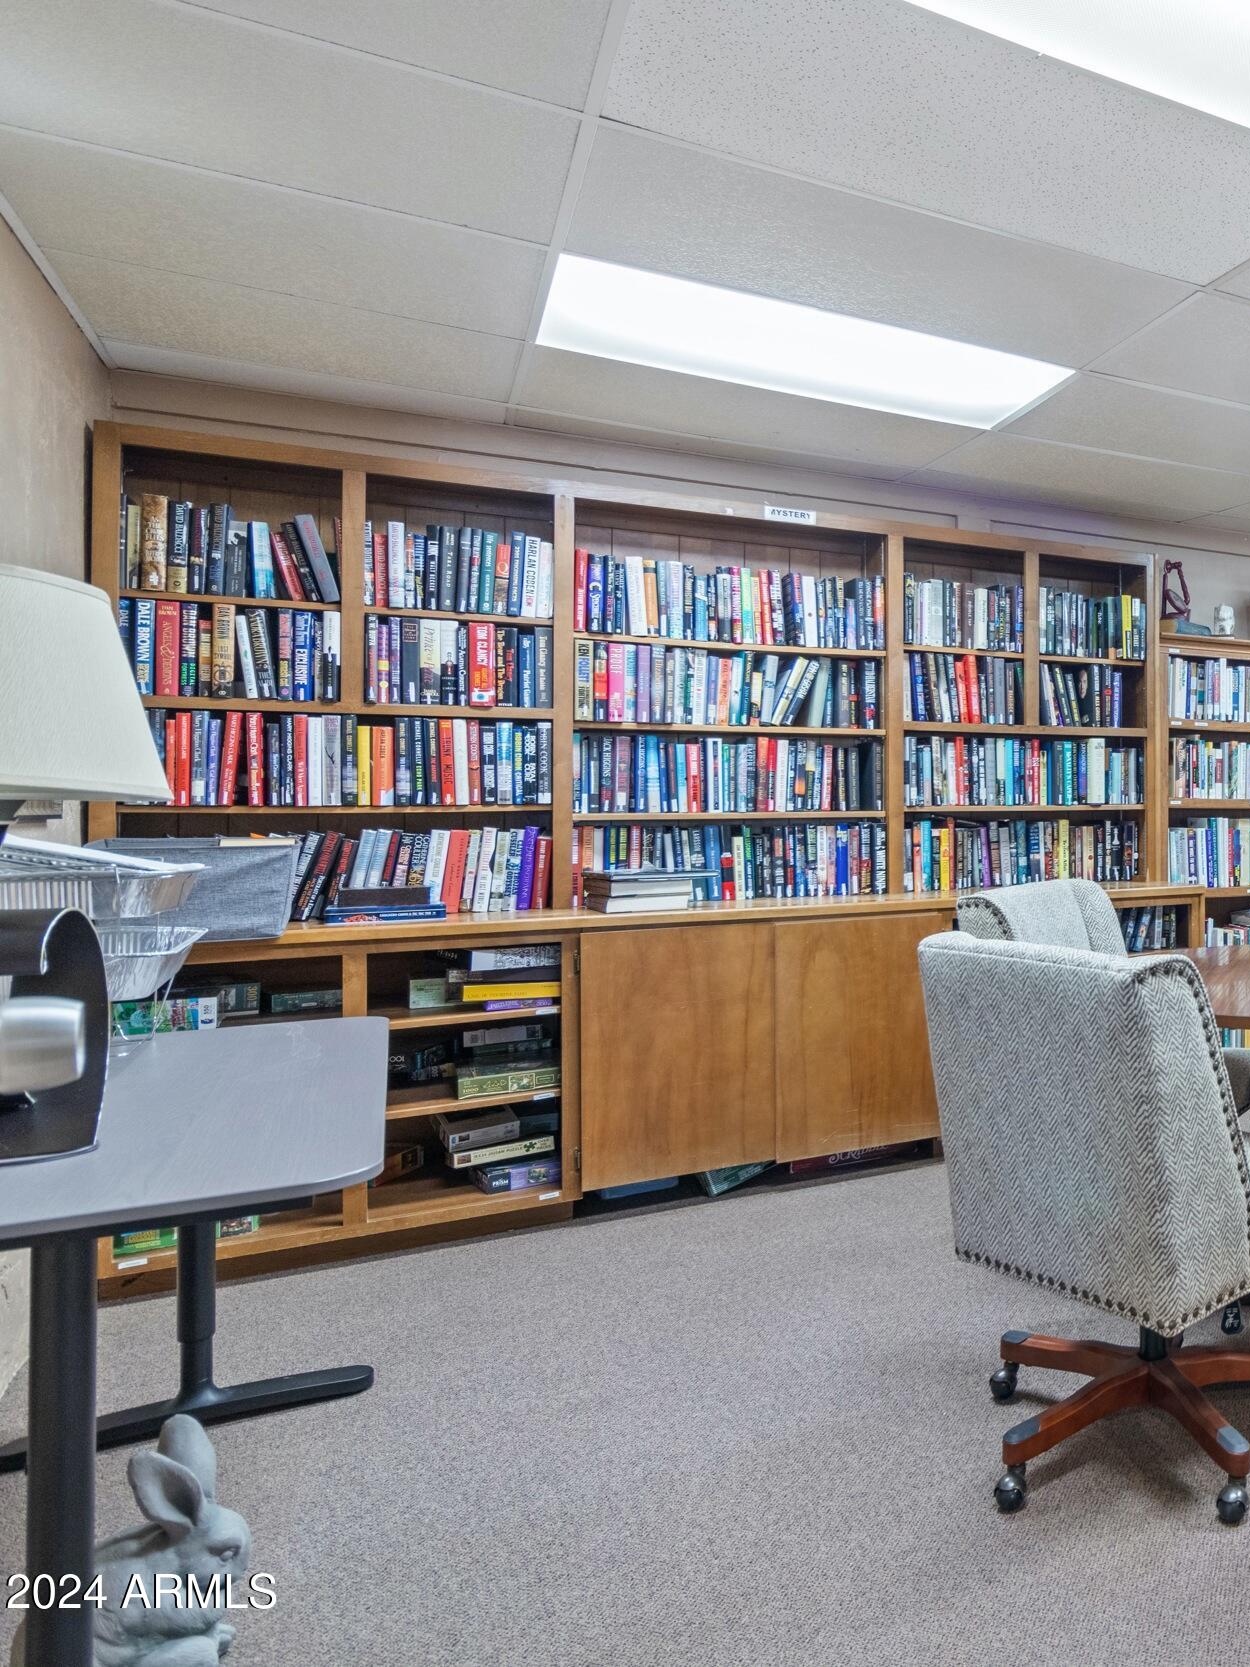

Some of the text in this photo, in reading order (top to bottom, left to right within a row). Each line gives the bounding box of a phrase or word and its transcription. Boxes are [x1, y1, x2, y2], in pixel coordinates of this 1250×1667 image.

[173, 504, 185, 553] DAVID BALDACCI
[525, 539, 538, 594] HARLAN COBEN
[137, 602, 151, 661] DALE BROWN
[182, 609, 196, 658] DAN BROWN
[218, 607, 229, 639] DAN BROWN
[162, 621, 173, 684] ANGELS DEMONS
[254, 638, 268, 664] BROWN
[476, 626, 488, 665] TOM CLANCY
[610, 648, 621, 674] PROOF
[181, 663, 189, 687] FORTRESS
[295, 649, 307, 684] EXCLUSIVE
[578, 643, 590, 683] KEN FOLLETT
[654, 659, 664, 690] Elizabeth
[194, 714, 203, 728] Mary
[194, 749, 203, 762] Clark
[443, 737, 454, 785] TRUNK MUSIC
[540, 750, 548, 774] COOK
[602, 737, 611, 777] JACK HIGGINS
[411, 837, 423, 863] COULTER
[419, 837, 430, 863] CATHERINE
[509, 831, 518, 857] CUSSLER
[692, 830, 702, 851] LARSSON
[505, 872, 515, 897] ODYSSEY
[875, 849, 885, 889] WHITE NINJA
